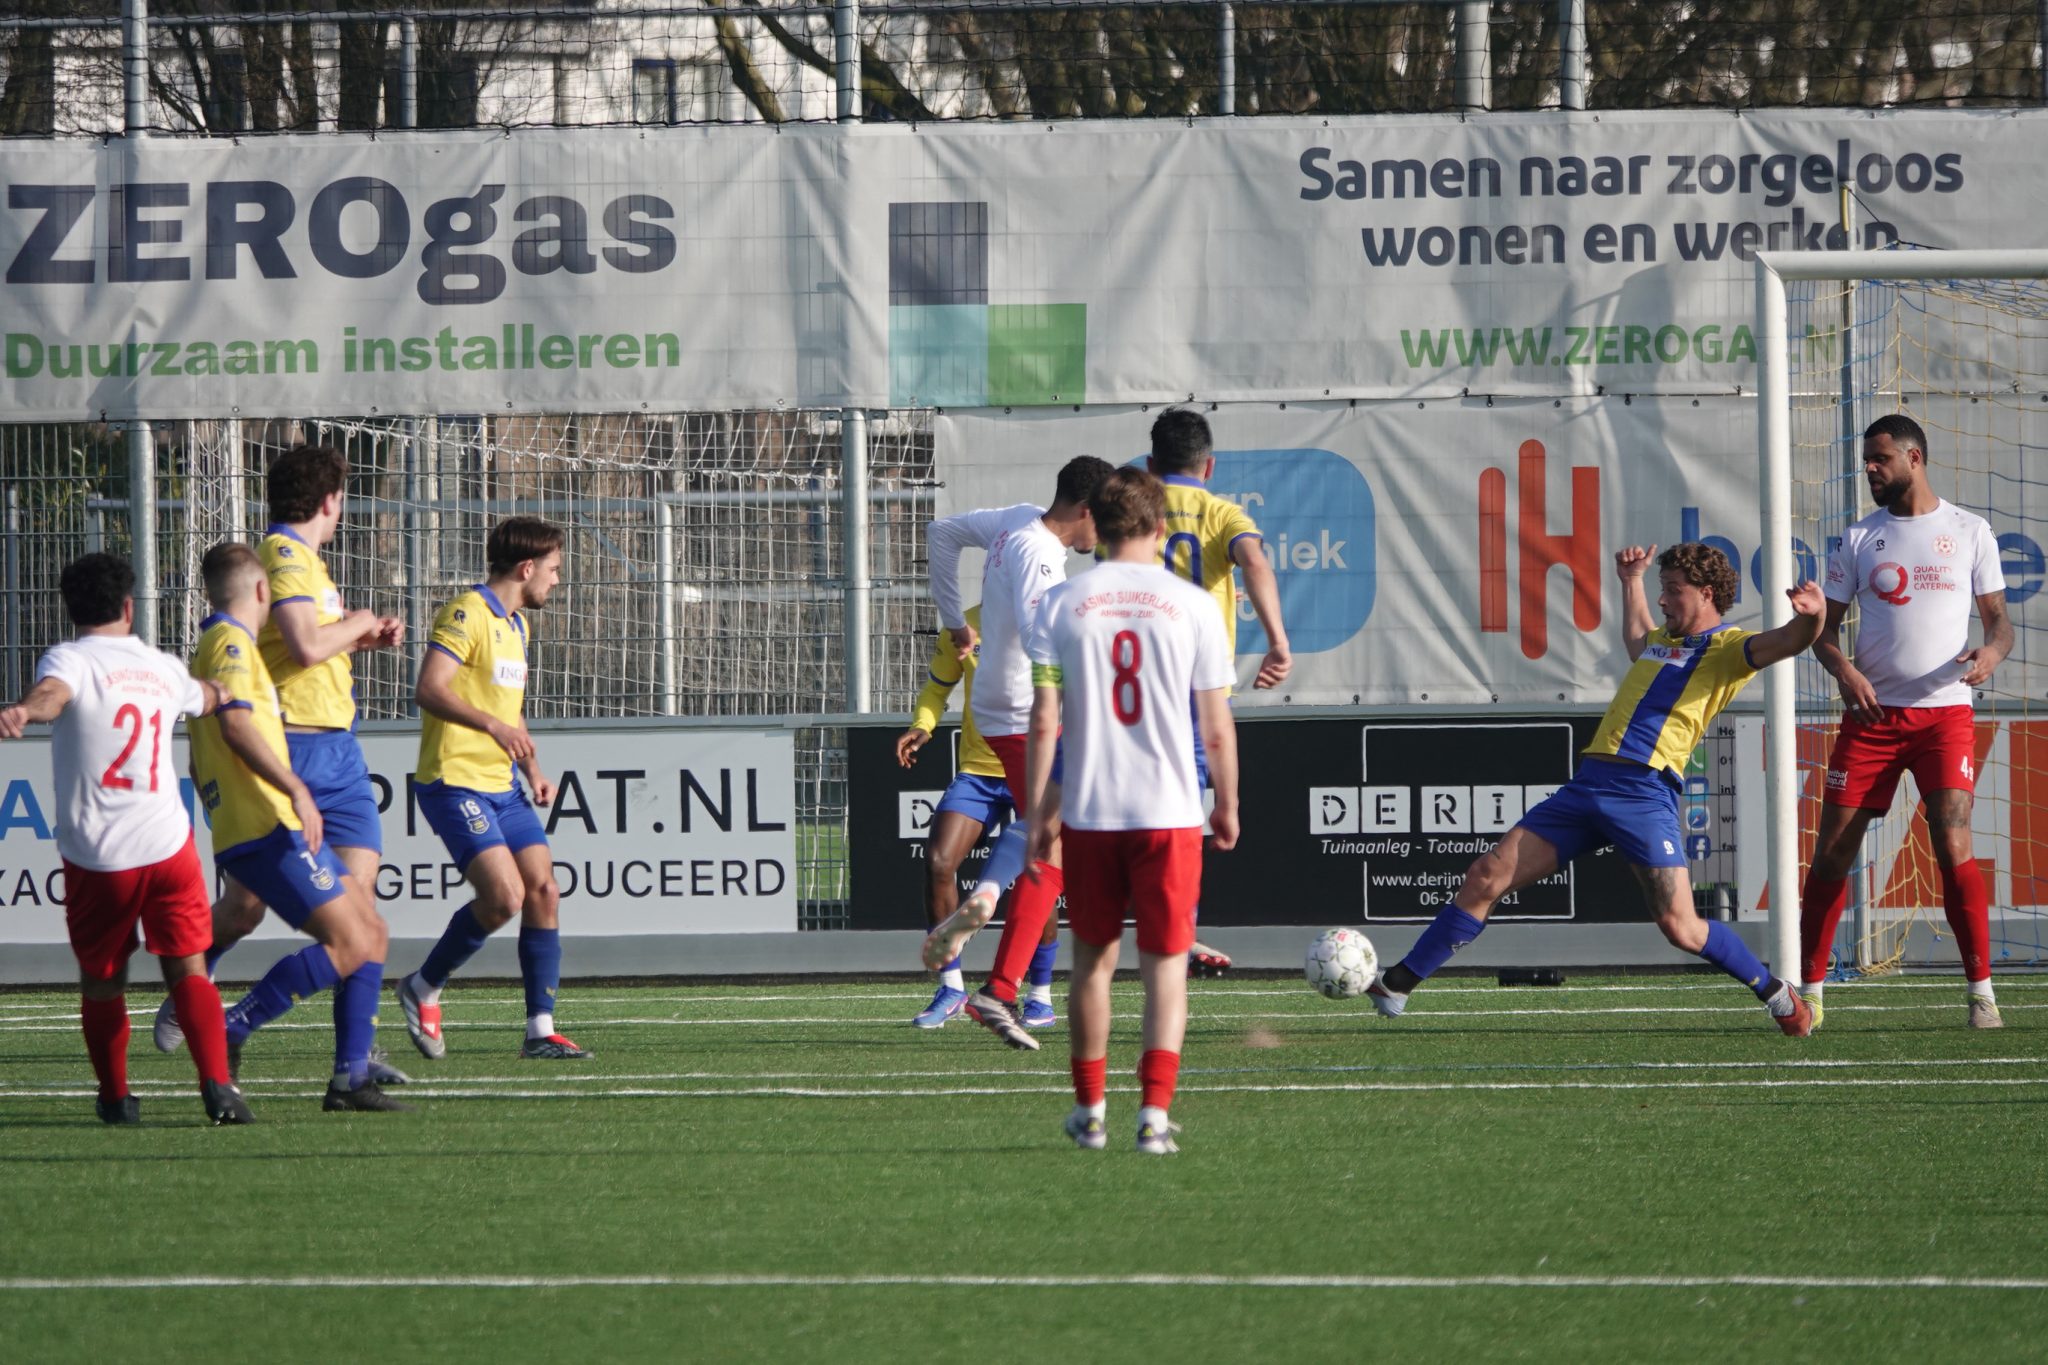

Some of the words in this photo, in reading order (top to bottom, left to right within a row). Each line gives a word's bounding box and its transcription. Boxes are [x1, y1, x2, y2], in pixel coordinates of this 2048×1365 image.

[1300, 147, 1501, 200] Samen
[1519, 152, 1652, 197] naar
[1667, 139, 1963, 207] zorgeloos
[5, 176, 677, 305] ZEROgas
[1361, 224, 1566, 267] wonen
[1583, 220, 1656, 262] en
[1674, 207, 1899, 262] werken
[4, 331, 320, 379] Duurzaam
[343, 323, 681, 372] installeren
[1913, 566, 1952, 574] QUALITY
[1913, 574, 1939, 582] RIVER
[1913, 582, 1955, 591] CATERING
[1113, 630, 1141, 725] 8
[102, 704, 162, 793] 21
[1961, 756, 1968, 778] 4
[458, 801, 481, 818] 16
[1321, 838, 1411, 857] Tuinaanleg
[300, 851, 316, 868] 7
